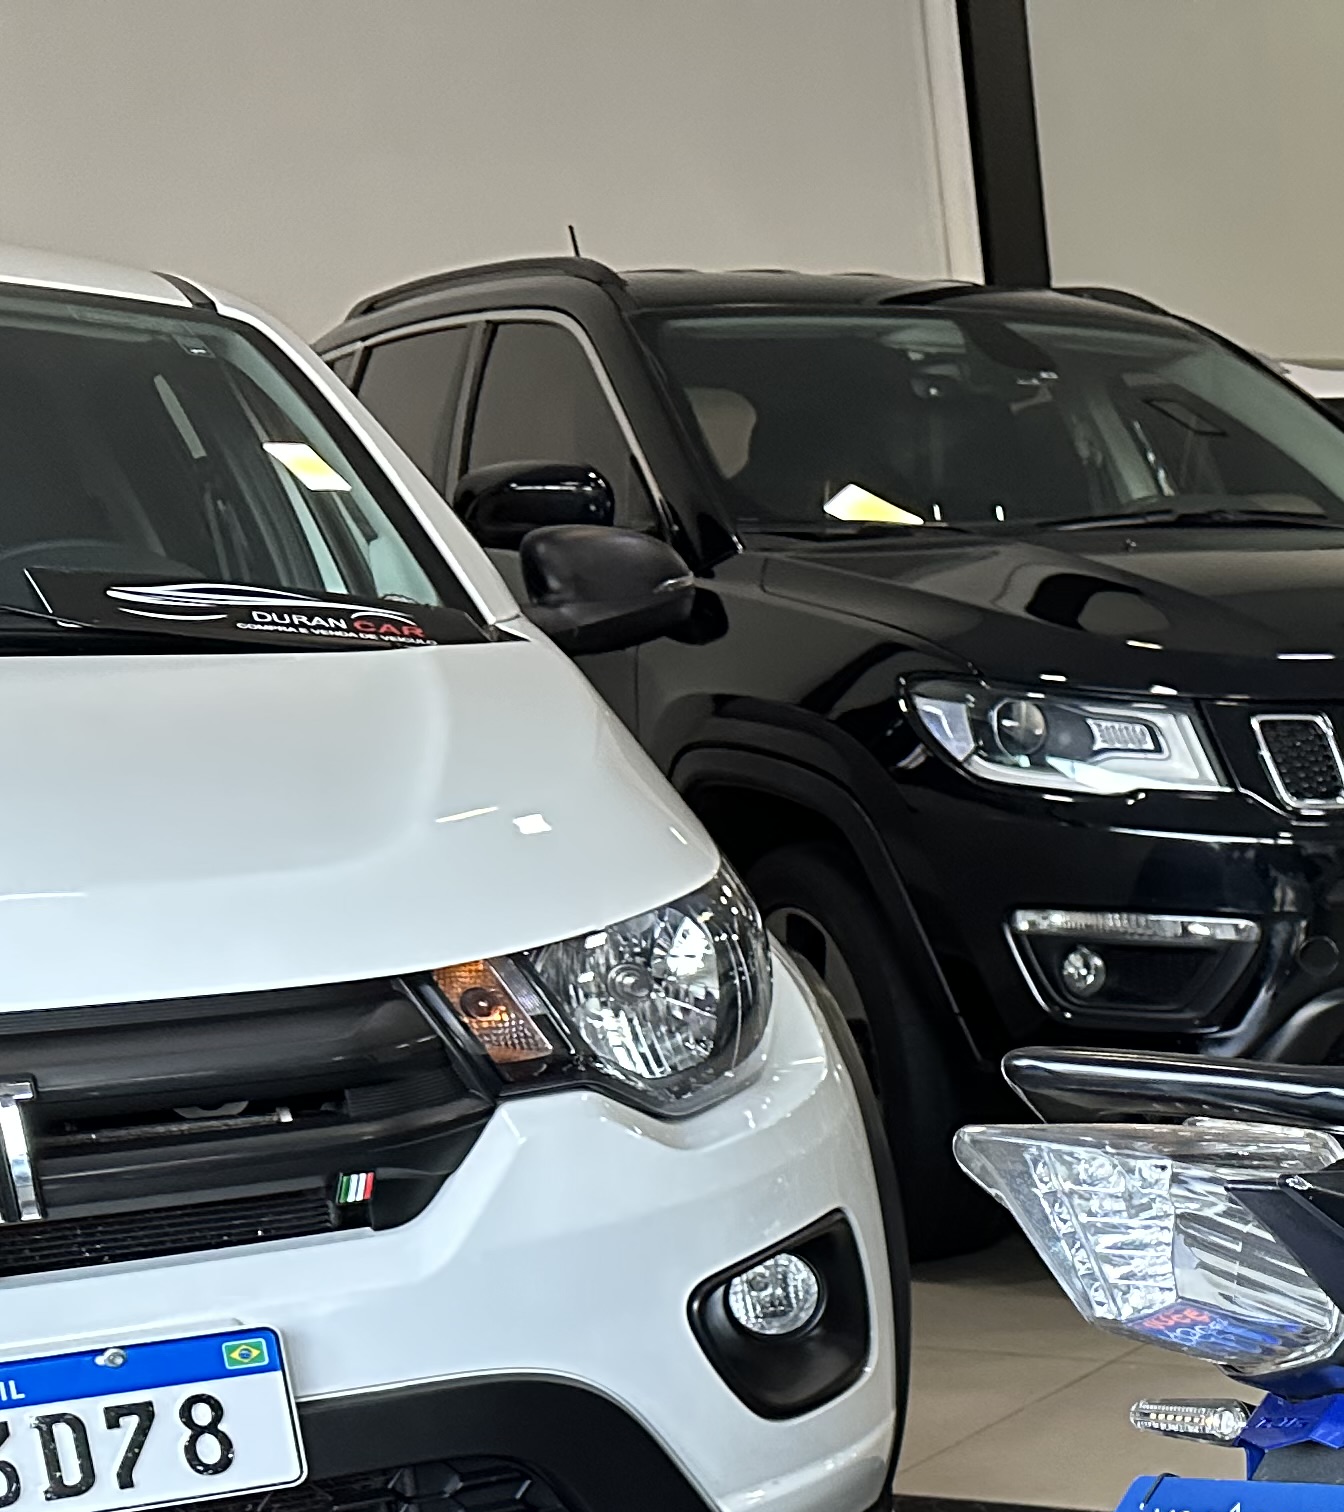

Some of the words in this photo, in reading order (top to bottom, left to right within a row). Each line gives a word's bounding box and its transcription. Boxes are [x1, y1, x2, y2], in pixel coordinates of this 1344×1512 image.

[236, 622, 299, 633] COMPRA
[310, 628, 359, 638] VENDA
[359, 633, 379, 641] DE
[252, 611, 348, 630] DURAN
[353, 620, 426, 638] CAR
